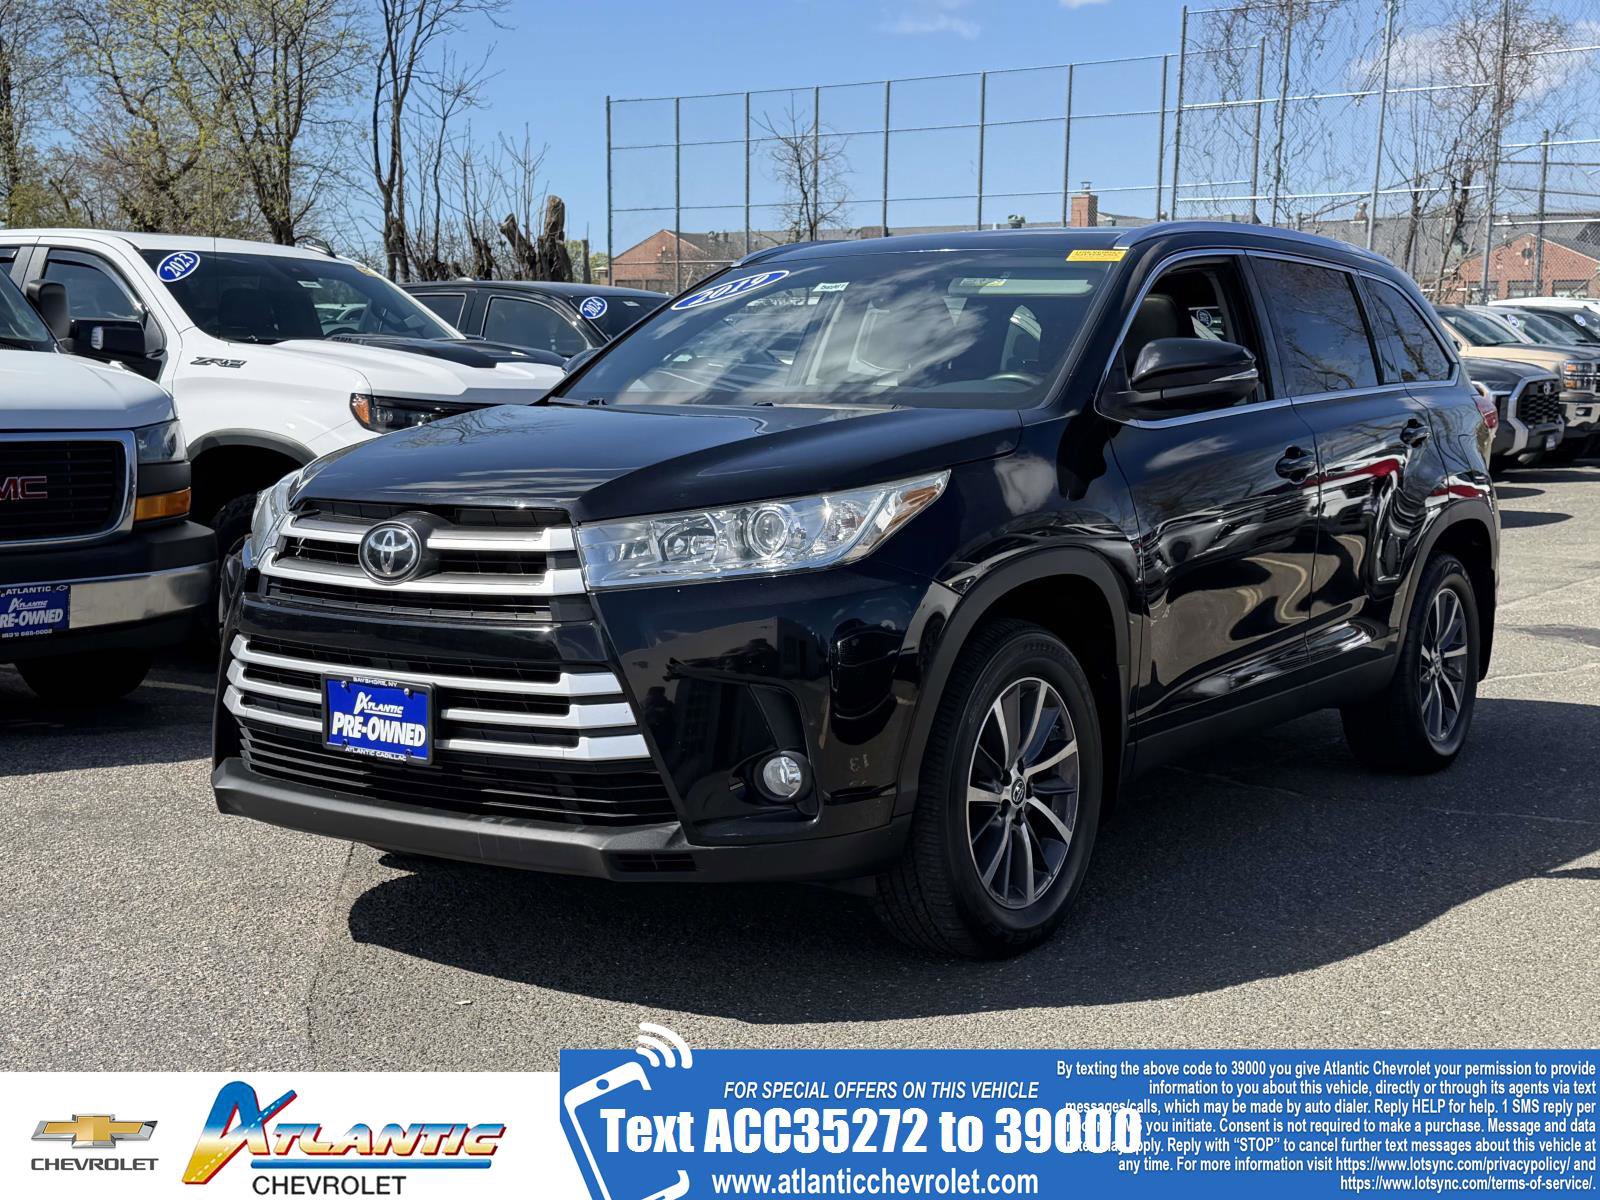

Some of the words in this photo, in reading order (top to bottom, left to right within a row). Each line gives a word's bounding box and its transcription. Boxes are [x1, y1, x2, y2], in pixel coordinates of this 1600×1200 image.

[164, 253, 195, 278] 2023
[688, 274, 771, 307] 2019
[6, 585, 52, 596] ATLANTIC
[353, 691, 404, 716] ATLANTIC
[331, 711, 426, 747] PRE-OWNED
[345, 746, 375, 756] ATLANTIC
[375, 750, 407, 762] CADILLAC
